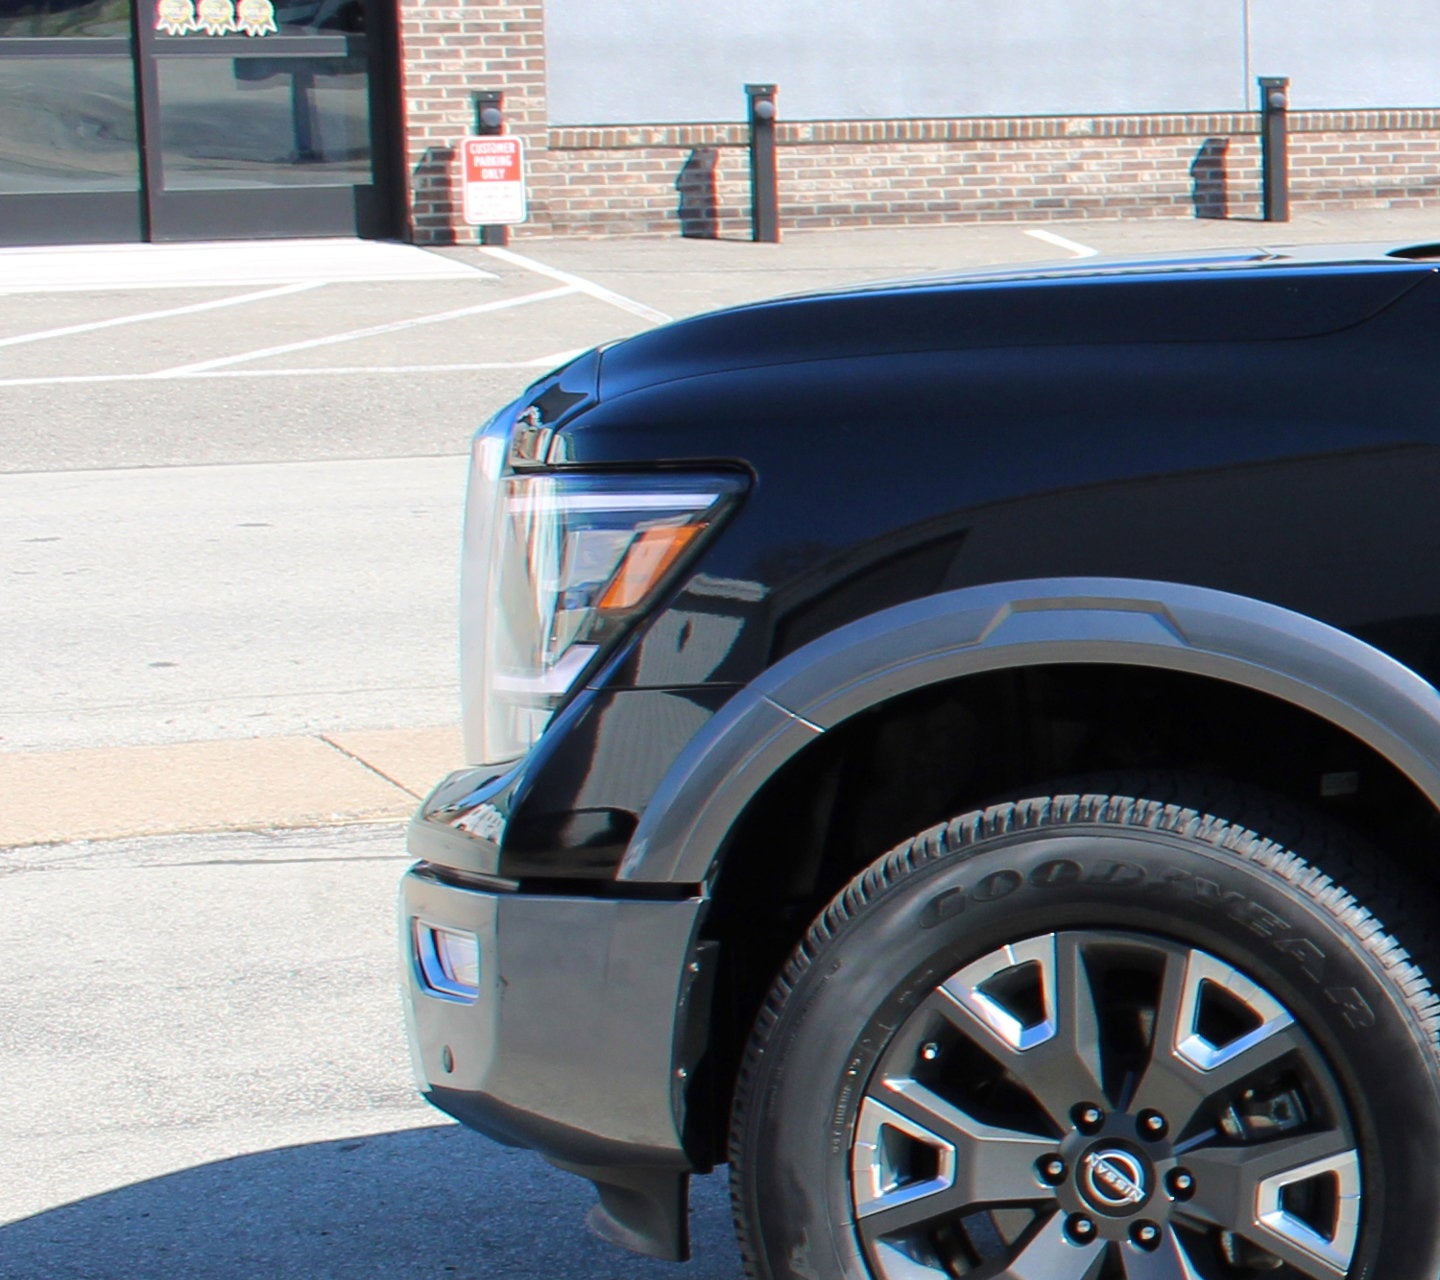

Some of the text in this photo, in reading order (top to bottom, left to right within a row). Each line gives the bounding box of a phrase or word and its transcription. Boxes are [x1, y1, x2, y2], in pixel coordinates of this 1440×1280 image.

[469, 143, 516, 155] CUSTOMER
[473, 155, 513, 167] PARKING
[481, 168, 506, 180] ONLY
[919, 858, 1376, 1029] GOODYEAR
